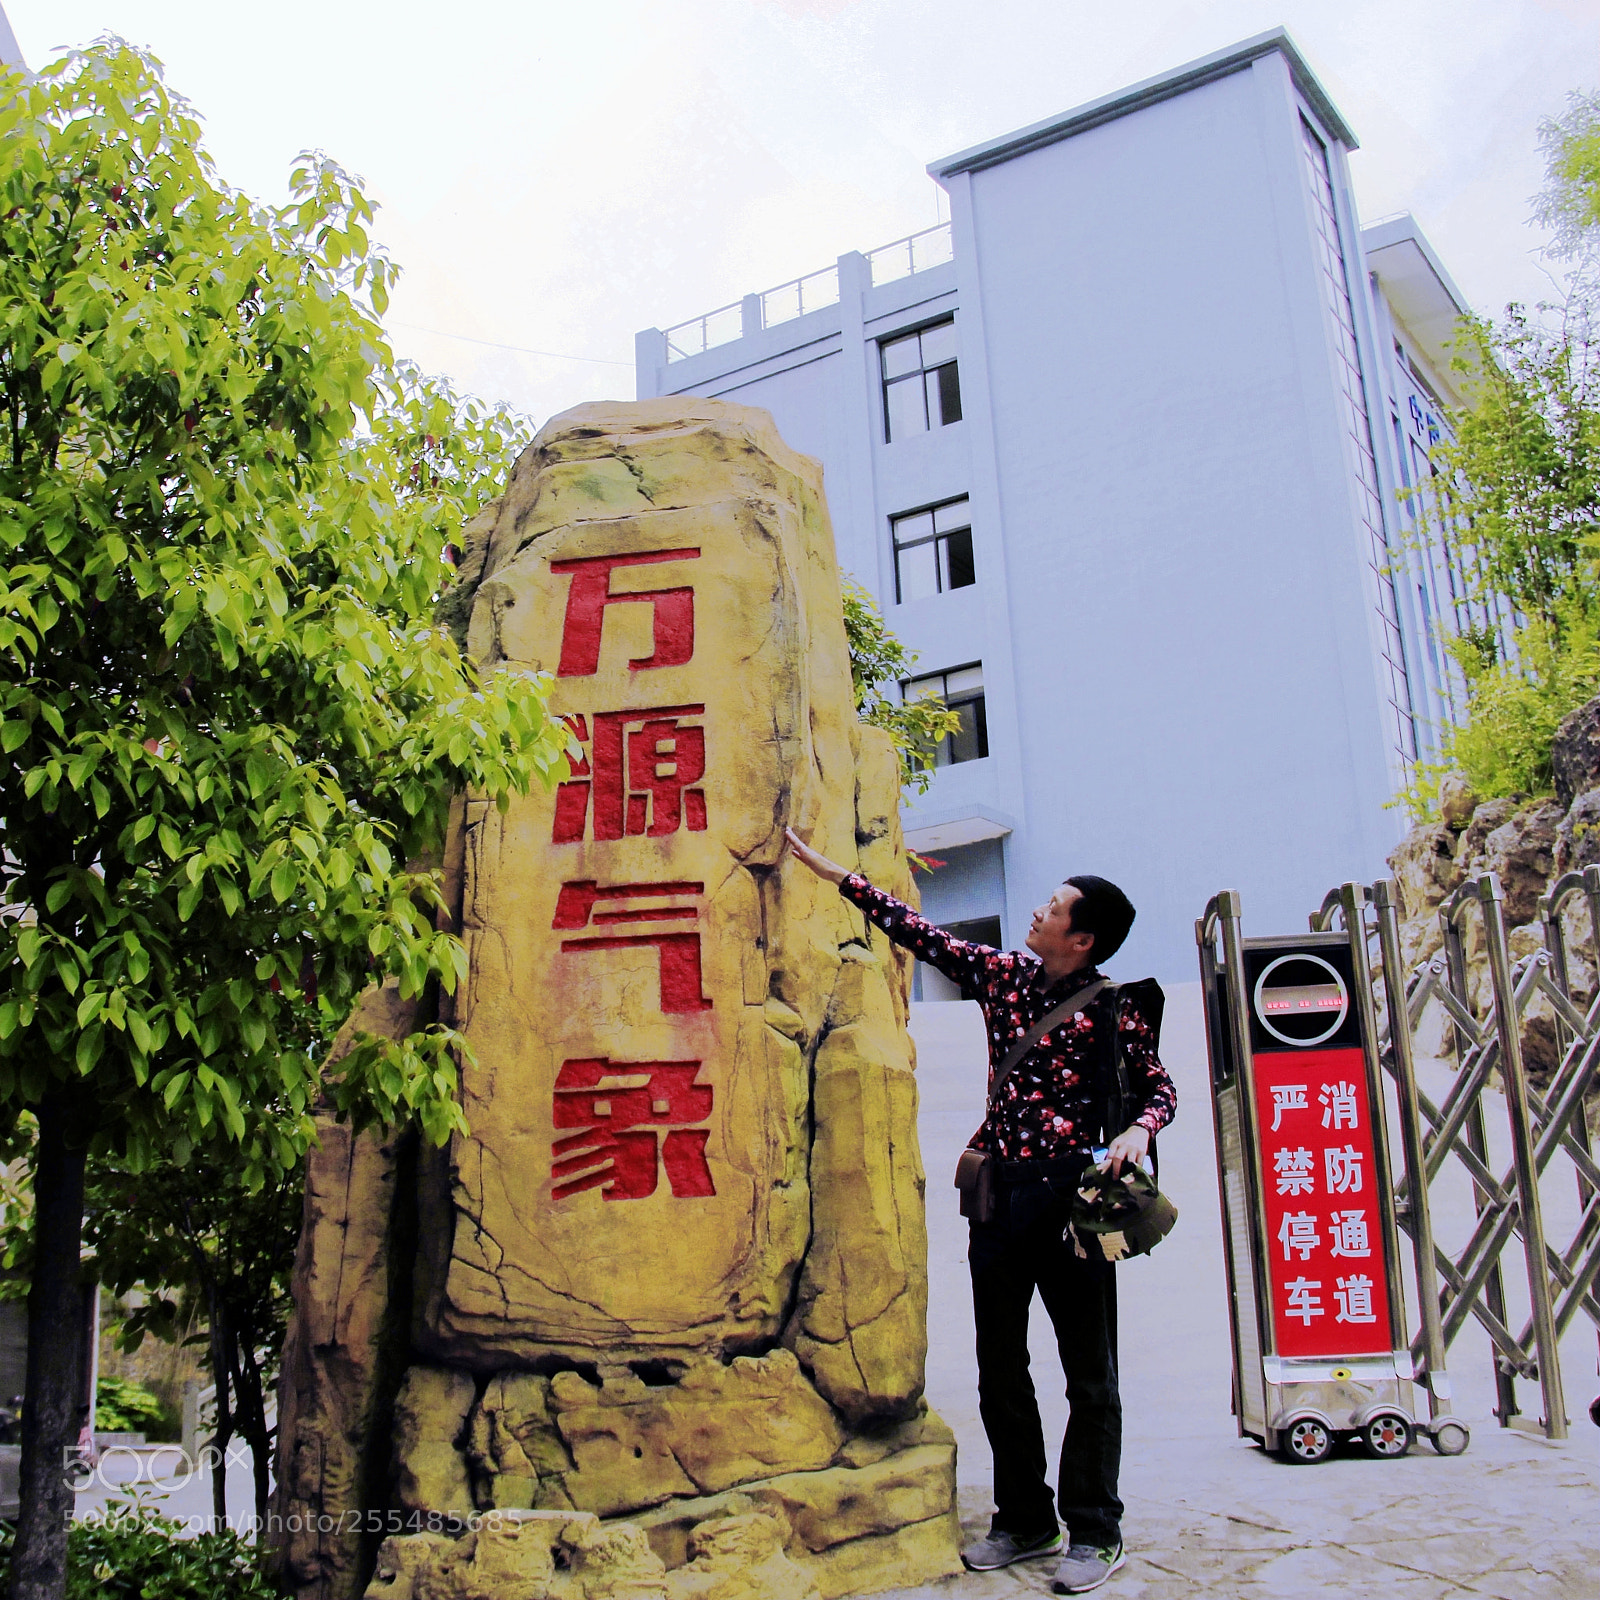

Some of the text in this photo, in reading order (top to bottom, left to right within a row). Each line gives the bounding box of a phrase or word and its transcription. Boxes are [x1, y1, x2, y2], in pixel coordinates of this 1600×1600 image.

[550, 546, 716, 1202] 万源气象
[1270, 1084, 1325, 1326] 严禁停车
[1318, 1081, 1377, 1324] 消防通道
